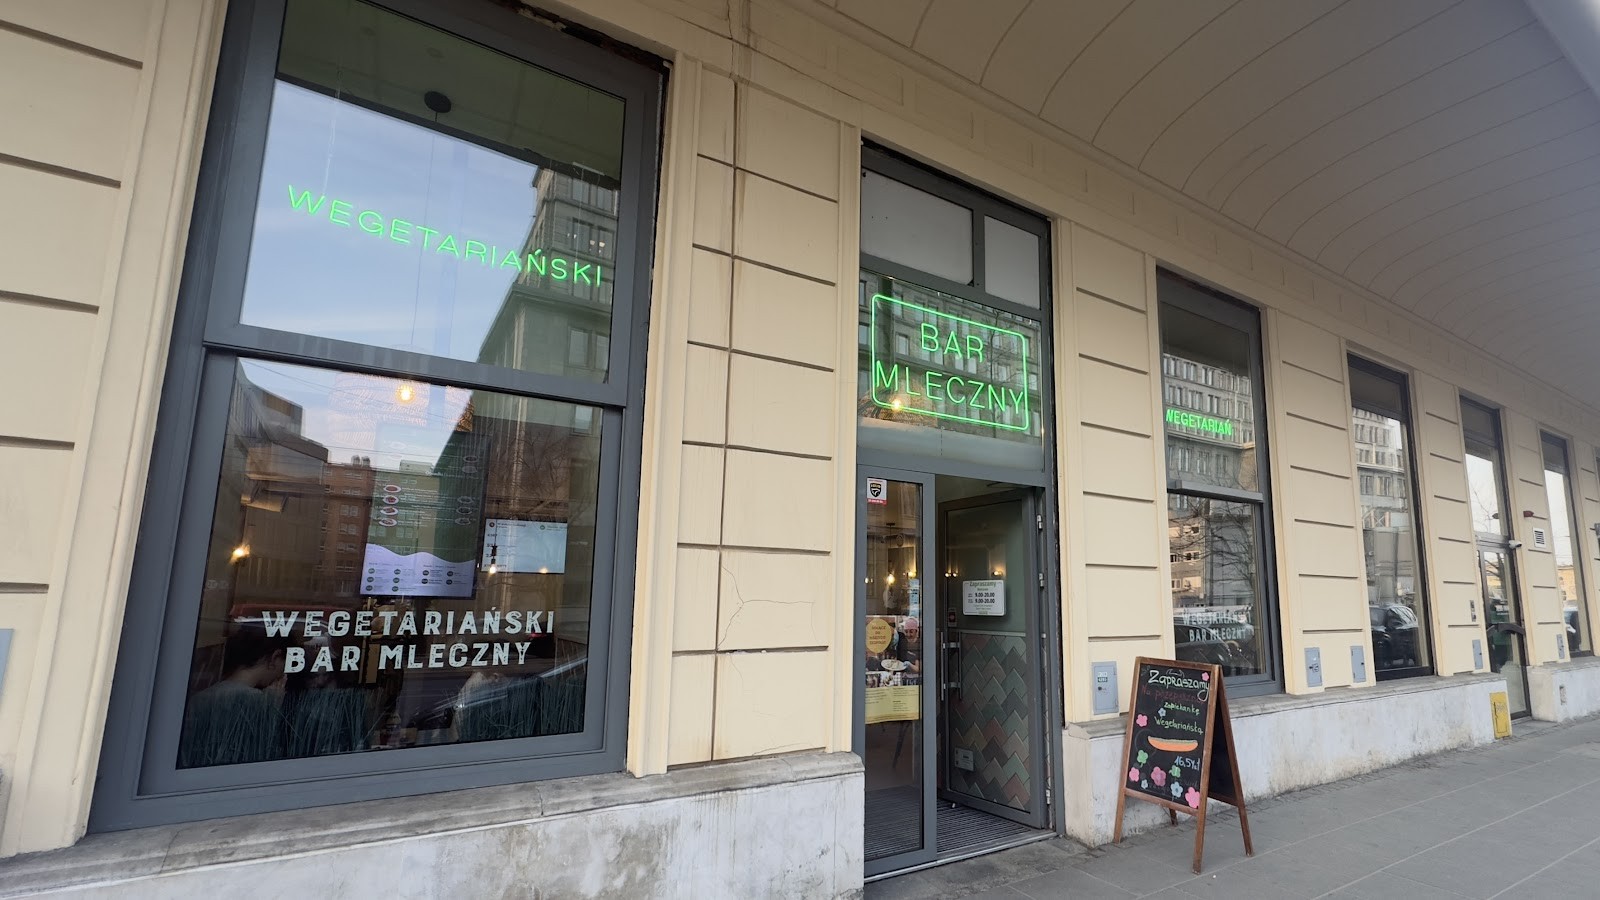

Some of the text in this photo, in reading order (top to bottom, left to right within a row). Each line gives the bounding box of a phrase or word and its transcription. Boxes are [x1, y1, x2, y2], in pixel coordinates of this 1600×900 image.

[288, 184, 602, 287] WEGETARIAŃSKI
[921, 322, 984, 363] BAR
[876, 360, 1024, 414] MLECZNY
[261, 606, 555, 638] WEGETARIAŃSKI
[1189, 628, 1207, 642] BAR
[284, 641, 532, 674] BAR MLECZNY
